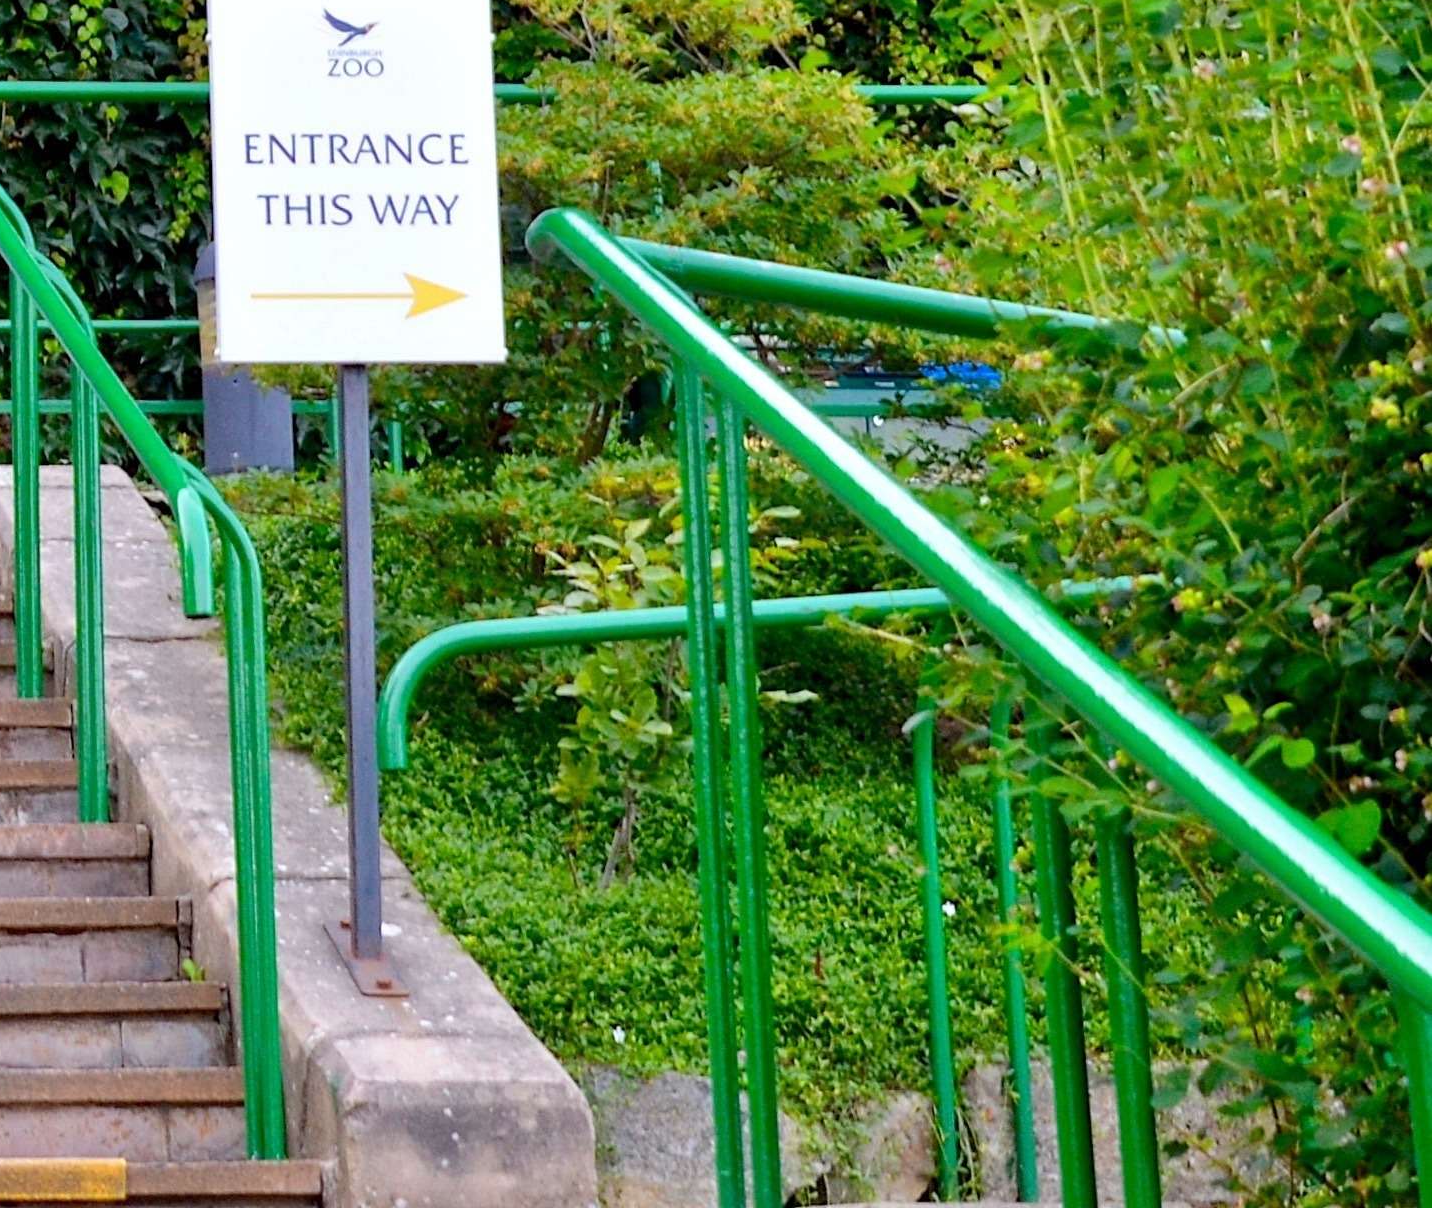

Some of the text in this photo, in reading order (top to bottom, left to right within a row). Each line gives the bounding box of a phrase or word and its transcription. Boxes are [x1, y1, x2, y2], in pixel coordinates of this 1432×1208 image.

[327, 58, 385, 77] ZOO
[244, 133, 470, 165] ENTRANCE
[257, 194, 459, 226] THIS WAY
